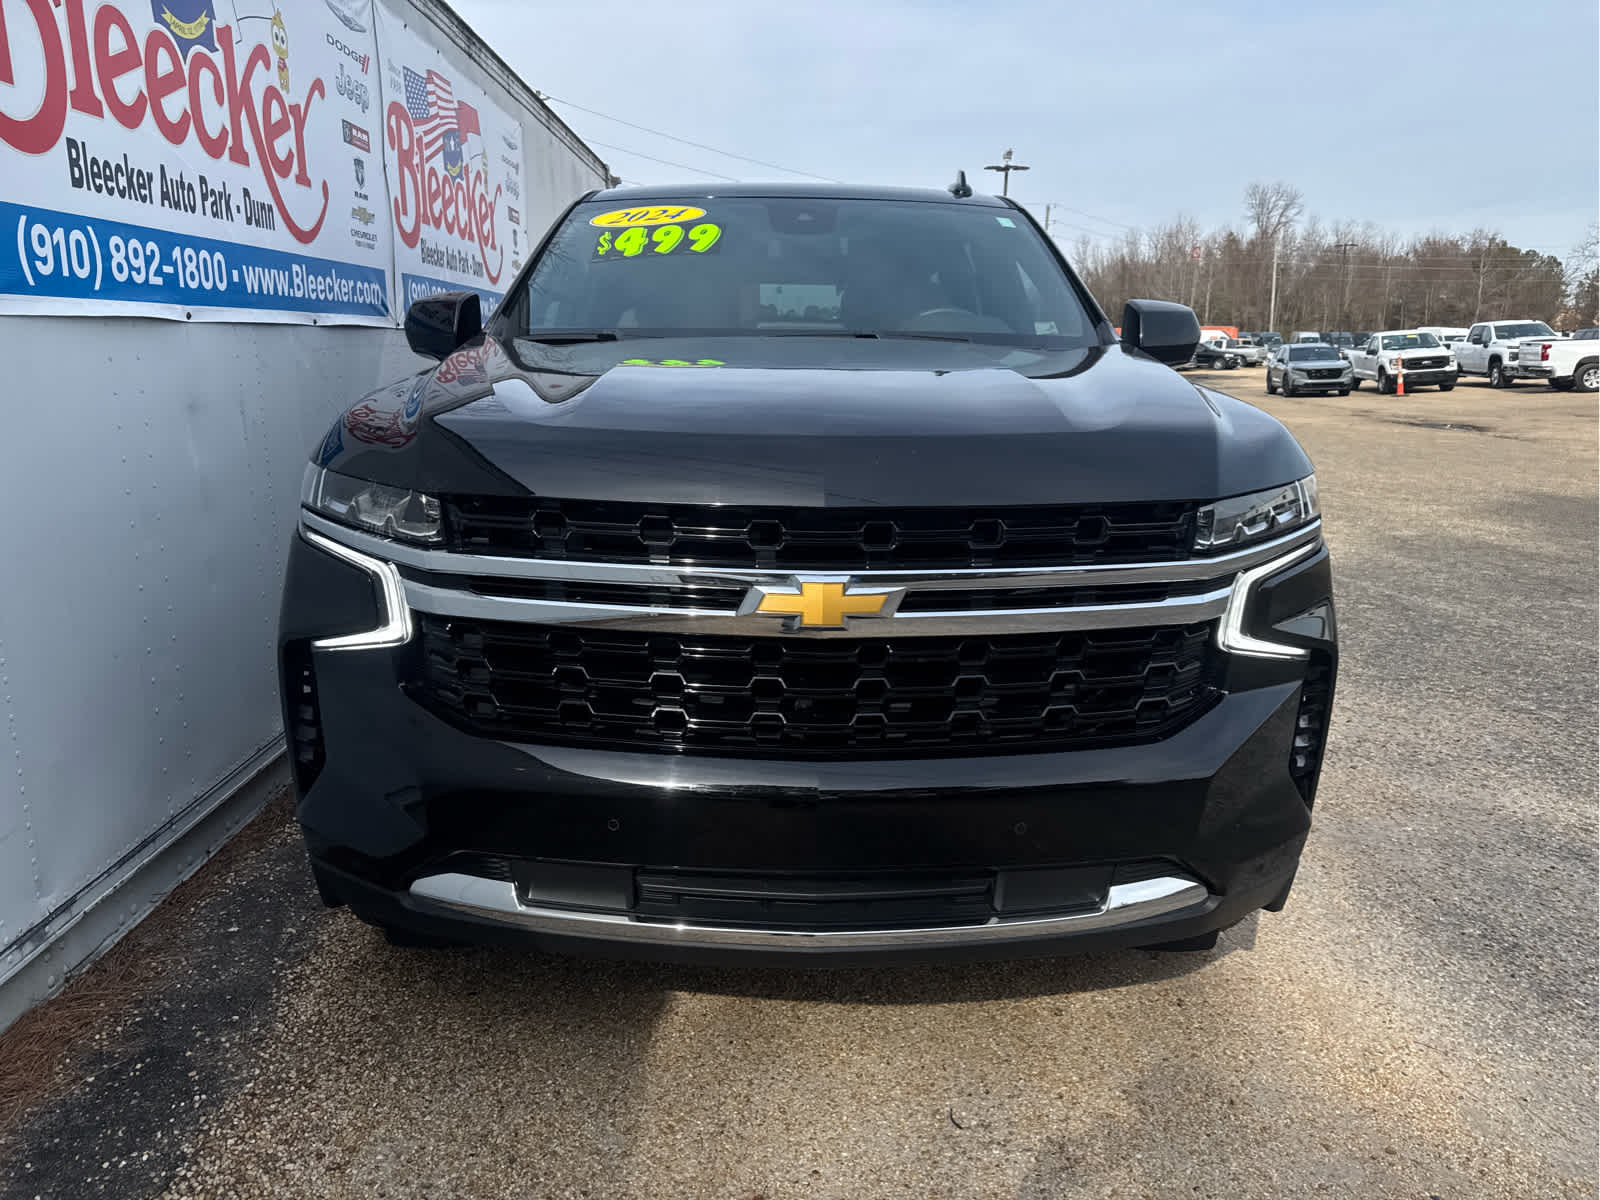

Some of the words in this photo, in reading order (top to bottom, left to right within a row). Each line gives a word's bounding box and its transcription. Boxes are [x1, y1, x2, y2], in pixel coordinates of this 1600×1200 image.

[326, 33, 366, 65] DODGE
[0, 0, 329, 244] leecker
[336, 62, 369, 113] Jeep
[66, 137, 153, 204] Bleecker
[160, 164, 196, 214] Auto
[199, 174, 234, 222] Park
[243, 187, 275, 231] Dunn
[387, 101, 503, 285] Bleecker
[607, 209, 688, 224] 2024
[17, 215, 102, 290] (910)
[109, 236, 227, 291] 892-1800
[242, 264, 382, 304] www.Bleecker.com
[597, 223, 722, 257] $499
